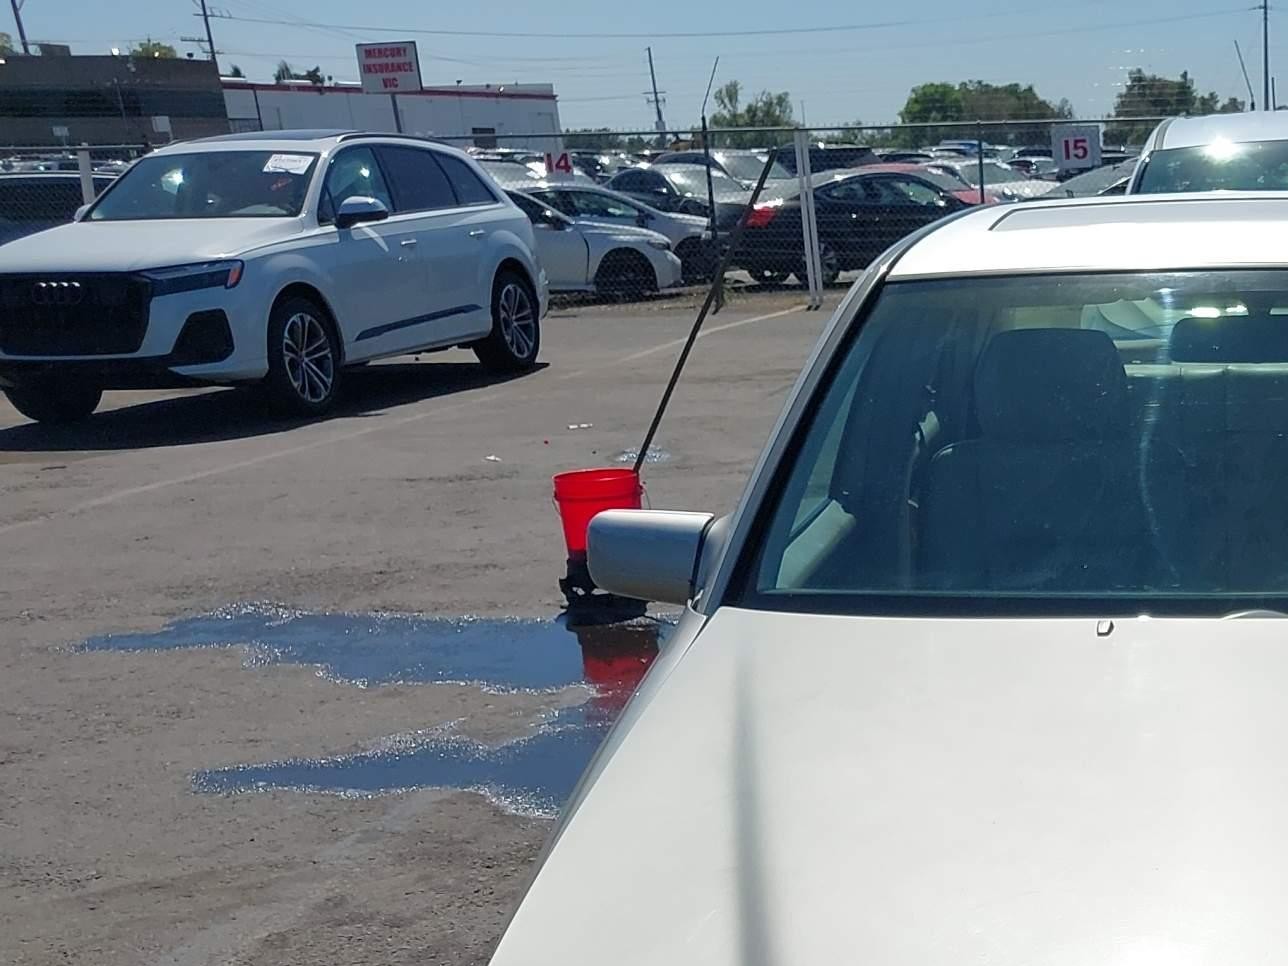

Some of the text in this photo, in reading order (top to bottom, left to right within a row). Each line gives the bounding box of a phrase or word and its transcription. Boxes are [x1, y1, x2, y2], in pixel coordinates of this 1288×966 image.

[364, 47, 407, 58] MERCURY
[363, 61, 413, 74] INSURANCE
[382, 77, 399, 89] VIC
[1063, 138, 1089, 160] 15
[546, 152, 572, 173] 14
